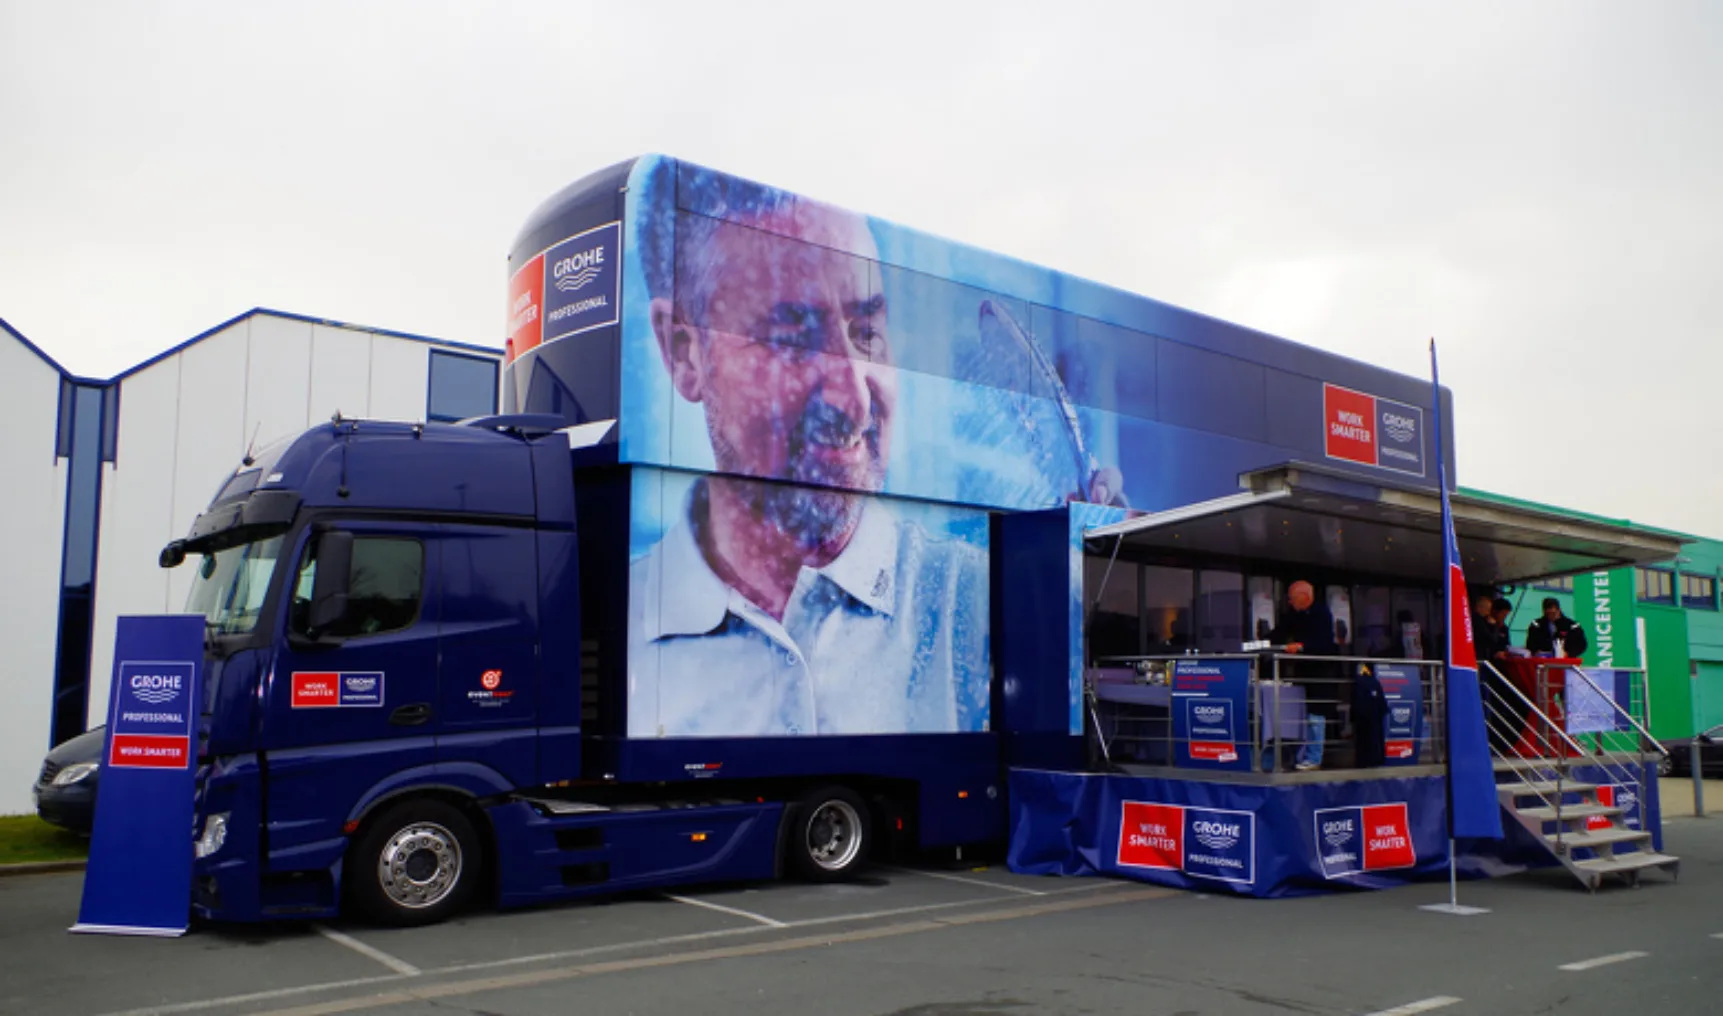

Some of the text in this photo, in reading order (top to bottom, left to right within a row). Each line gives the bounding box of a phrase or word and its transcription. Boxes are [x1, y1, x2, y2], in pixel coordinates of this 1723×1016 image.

[553, 246, 605, 279] GROHE
[548, 294, 608, 323] PROFESSIONAL
[1337, 410, 1364, 428] WORK
[1382, 412, 1416, 432] GROHE
[1331, 421, 1372, 443] SMARTER
[130, 675, 182, 690] GROHE
[122, 711, 184, 723] PROFESSIONAL
[120, 745, 182, 757] WORK SMARTER
[1139, 823, 1167, 836] WORK
[1192, 820, 1240, 838] GROHE
[1323, 819, 1354, 834] GROHE
[1376, 825, 1397, 837] WORK
[1128, 834, 1177, 852] SMARTER
[1369, 836, 1406, 852] SMARTER
[1188, 853, 1244, 869] PROFESSIONAL
